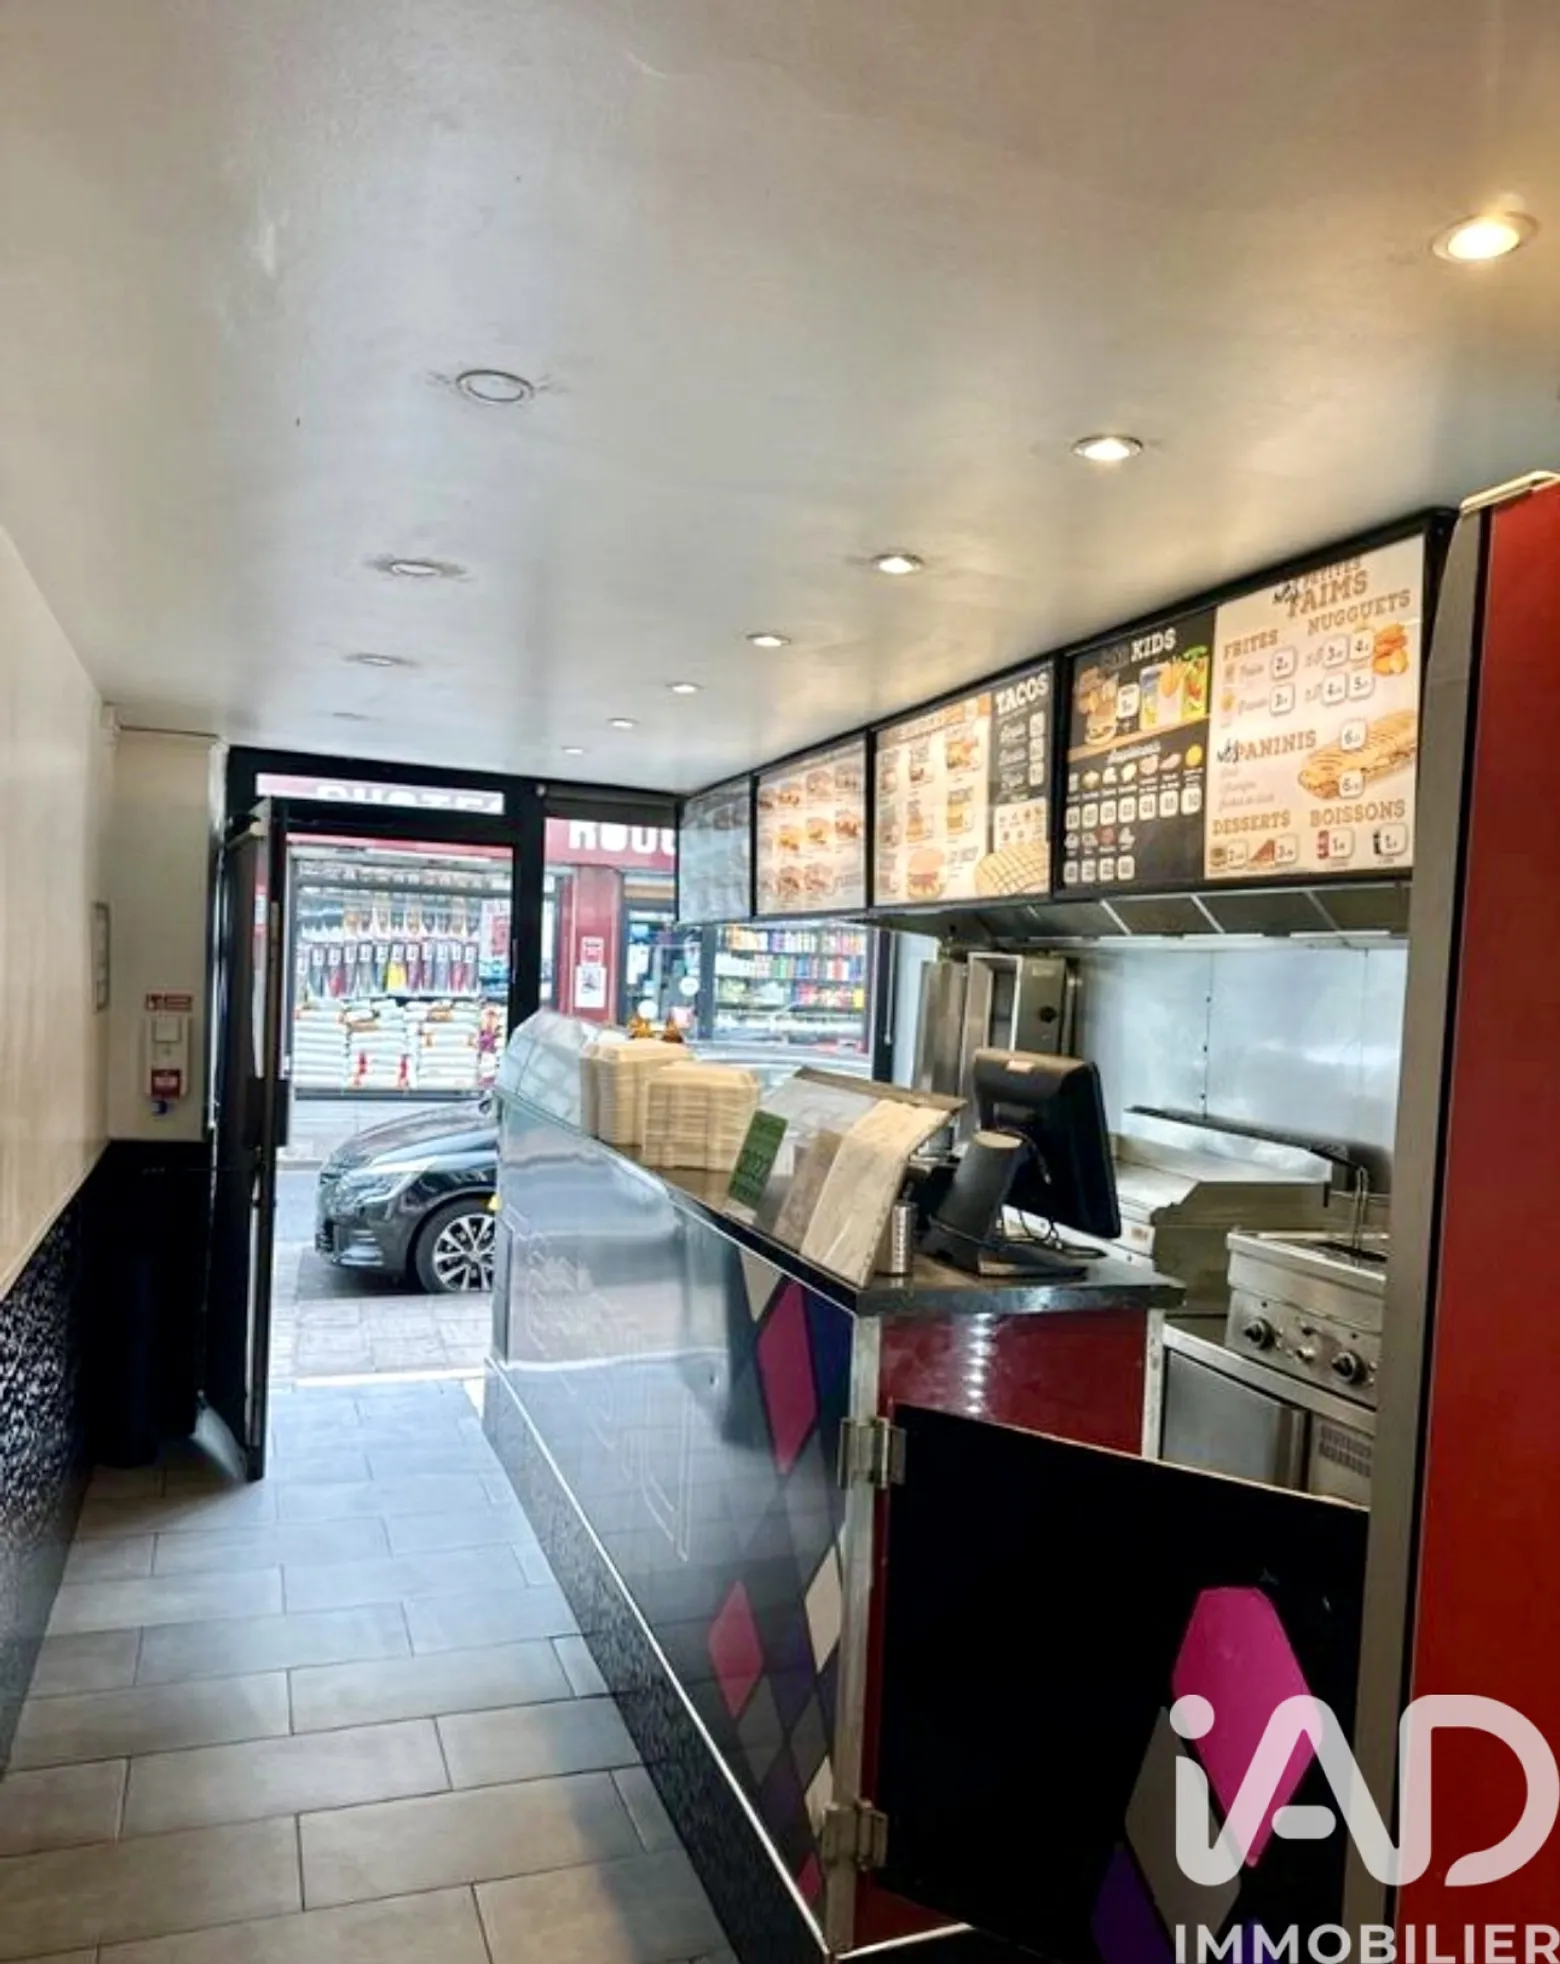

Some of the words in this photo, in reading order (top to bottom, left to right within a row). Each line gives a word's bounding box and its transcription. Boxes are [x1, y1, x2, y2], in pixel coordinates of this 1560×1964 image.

[1131, 627, 1176, 662] KIDS
[1223, 629, 1278, 660] FRITES
[996, 672, 1049, 715] TACOS
[1212, 810, 1291, 837] DESSERTS
[1310, 800, 1405, 827] BOISSONS
